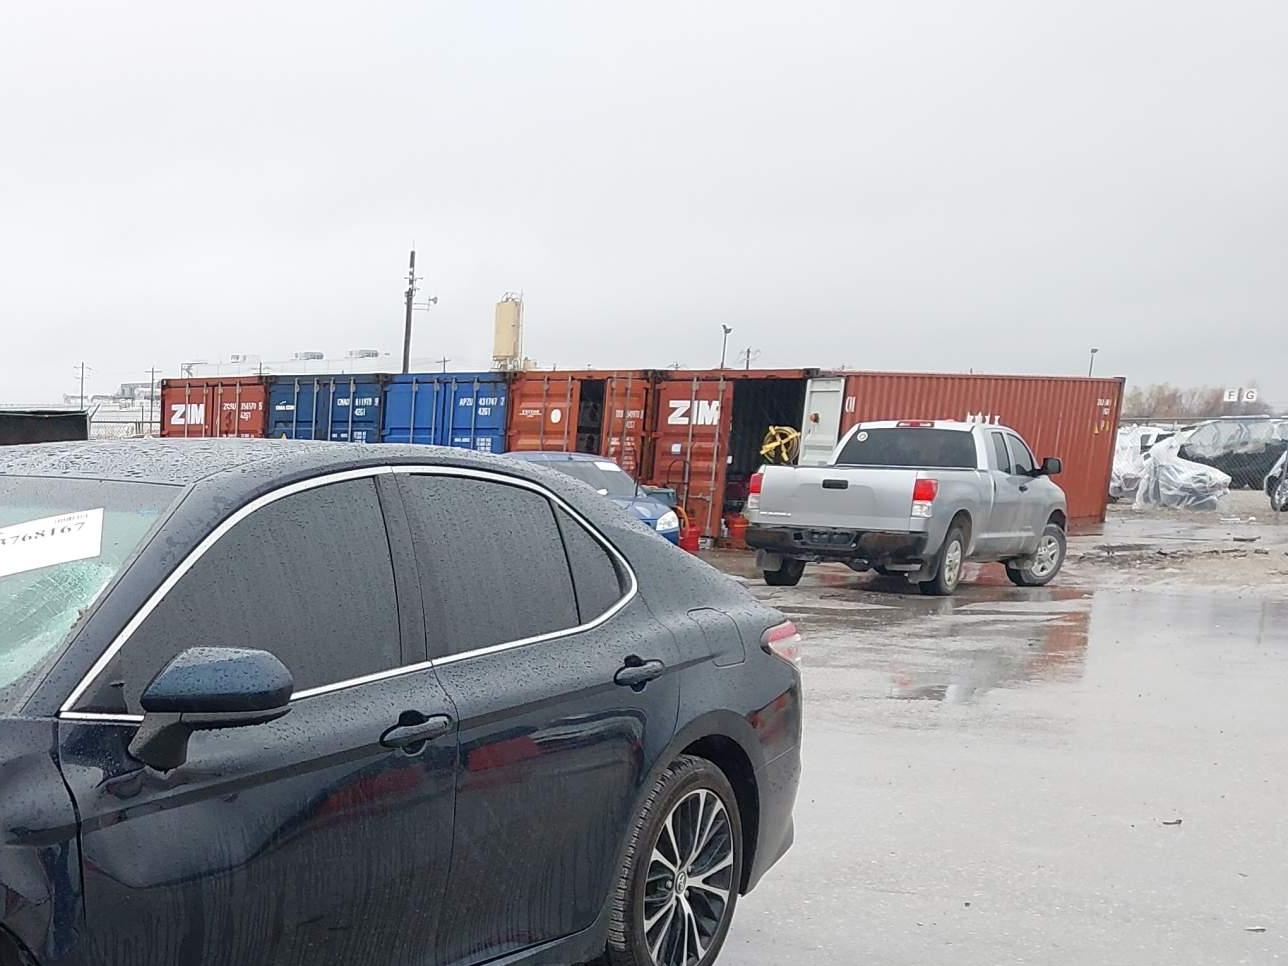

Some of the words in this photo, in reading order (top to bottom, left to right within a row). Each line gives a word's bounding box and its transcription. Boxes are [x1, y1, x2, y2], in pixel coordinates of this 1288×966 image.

[1246, 390, 1255, 400] G
[171, 404, 204, 424] ZIM
[668, 401, 720, 425] ZIM
